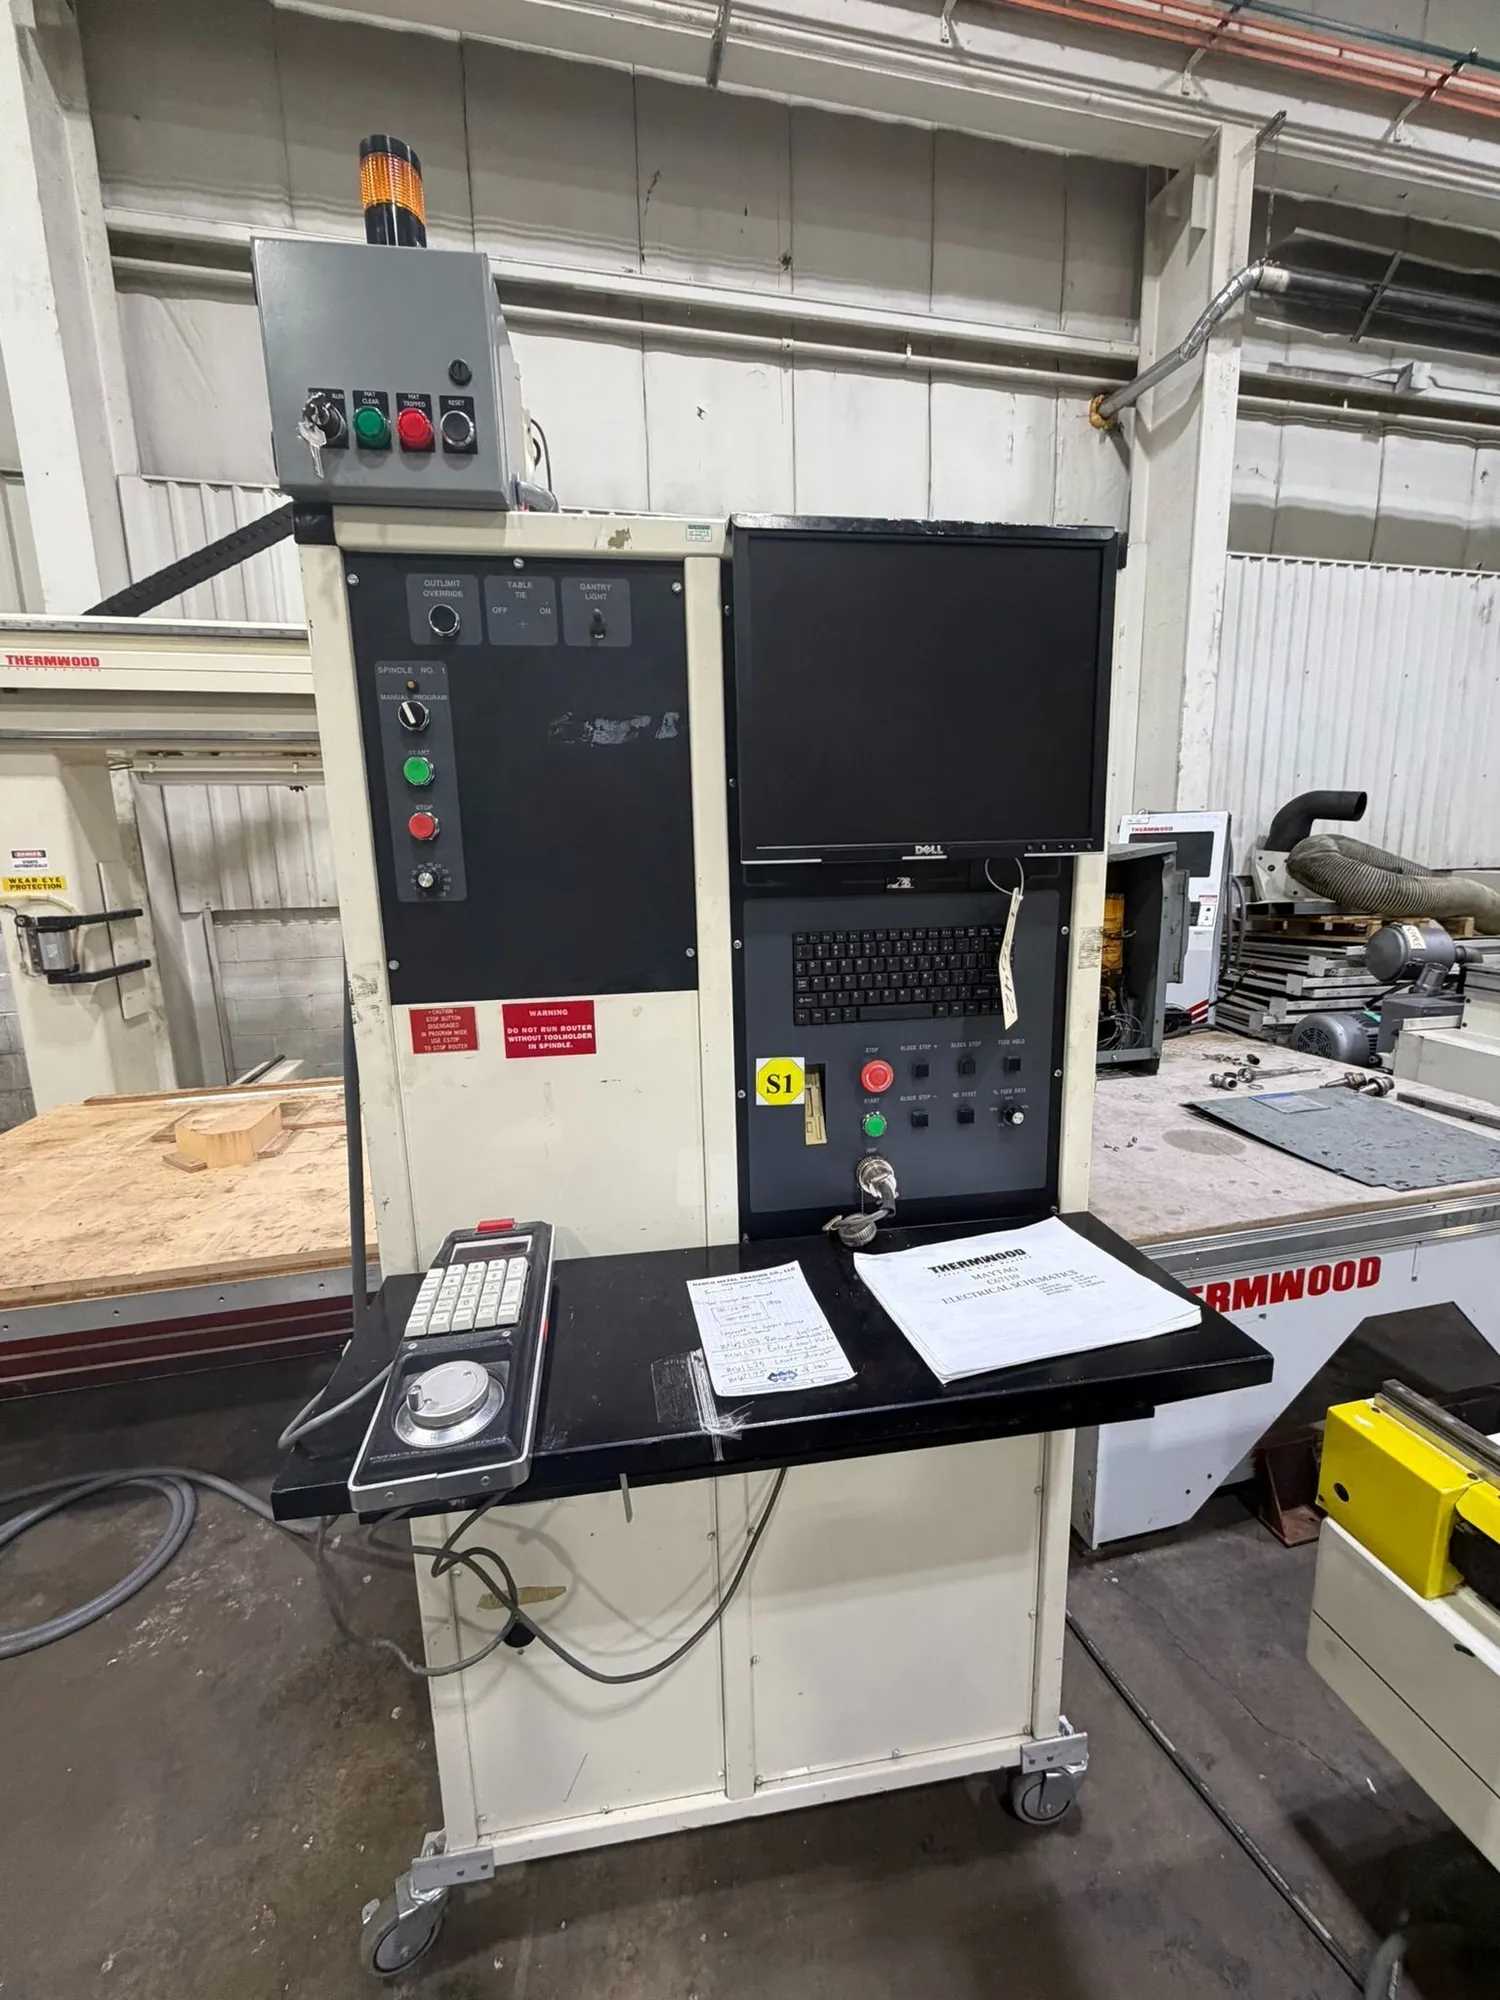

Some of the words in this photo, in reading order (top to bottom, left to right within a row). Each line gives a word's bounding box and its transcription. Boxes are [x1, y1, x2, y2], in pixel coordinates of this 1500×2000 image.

[506, 581, 533, 589] TABLE
[579, 583, 612, 591] GANTRY
[422, 590, 464, 598] OVERRIDE
[515, 591, 527, 599] TIE
[584, 593, 608, 601] LIGHT
[491, 606, 508, 614] OFF
[539, 607, 551, 615] ON
[5, 655, 100, 667] THERMWOOD
[377, 666, 413, 674] SPINDLE
[914, 845, 944, 855] DELL
[528, 1008, 569, 1017] WARNING
[560, 1024, 593, 1032] ROUTER
[507, 1034, 542, 1043] WITHOUT
[543, 1032, 593, 1041] TOOLHOLDER
[766, 1073, 793, 1095] S1
[927, 1247, 1027, 1275] THERMWOOD
[971, 1265, 1019, 1281] MAYTAG
[941, 1282, 1010, 1305] ELECTRICAL
[1010, 1269, 1079, 1290] SCHEMATICS
